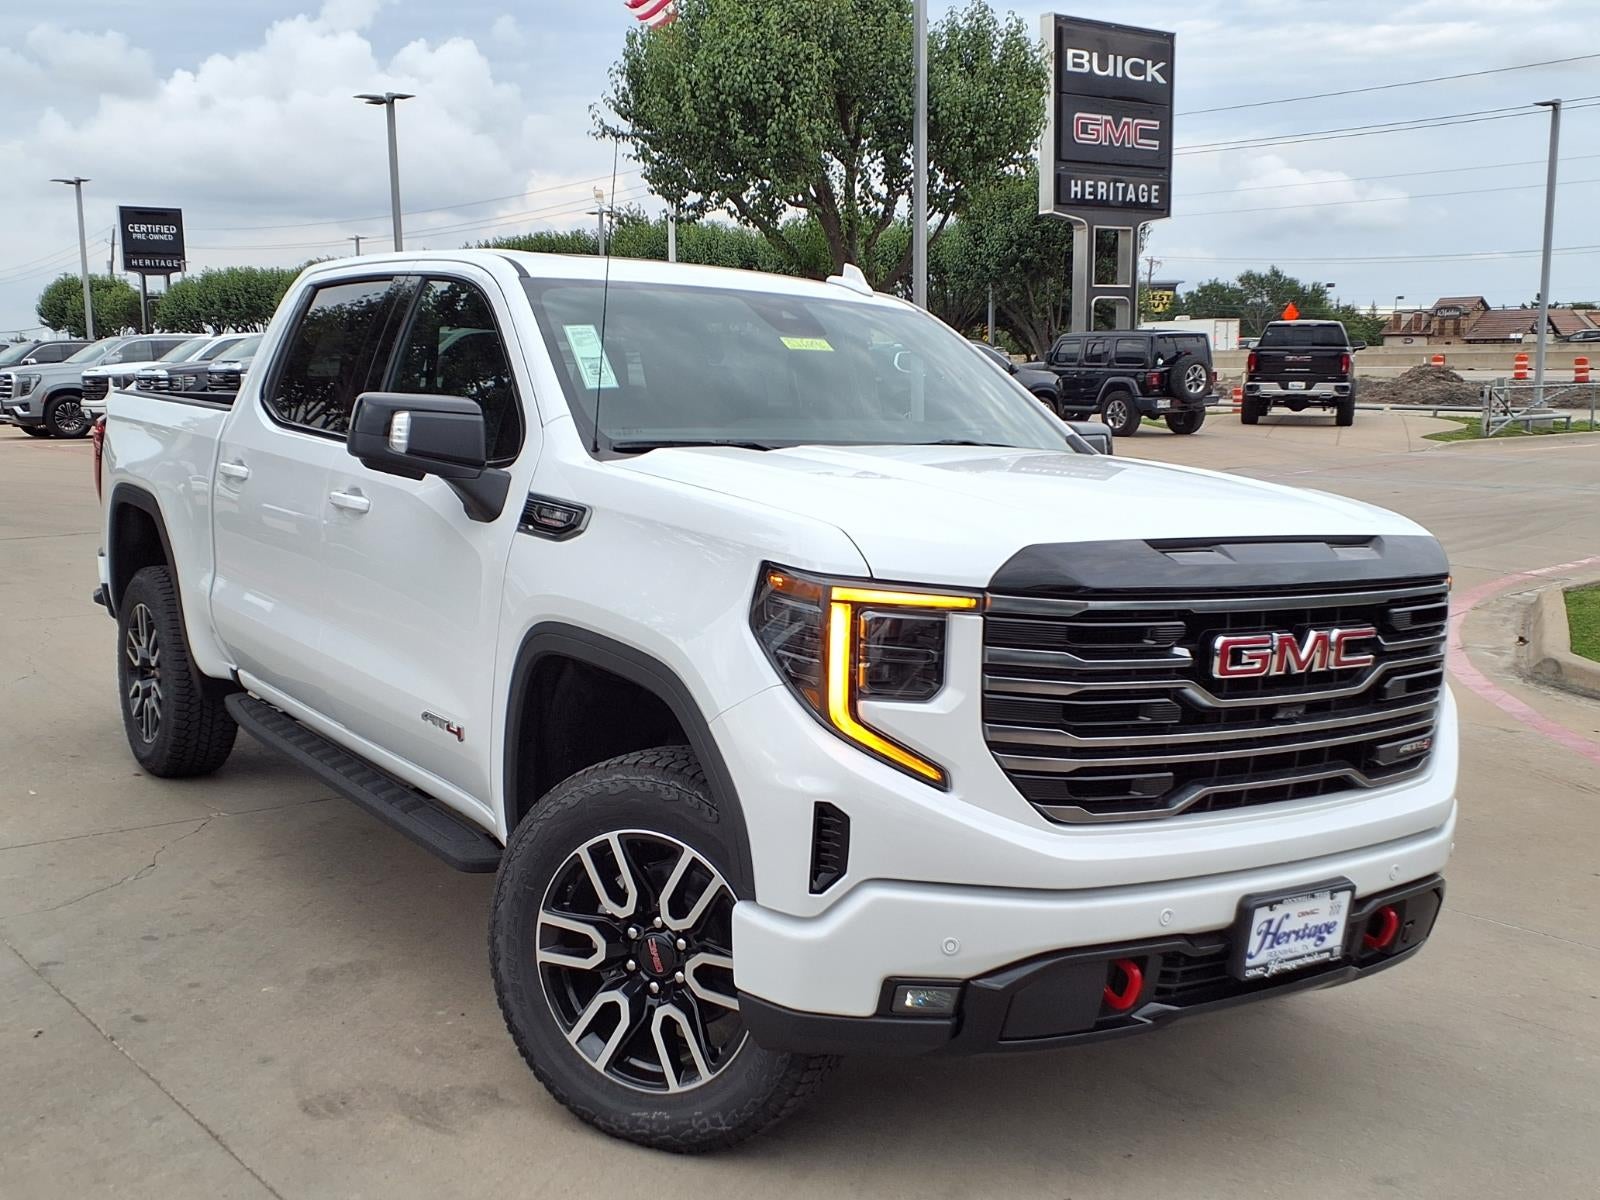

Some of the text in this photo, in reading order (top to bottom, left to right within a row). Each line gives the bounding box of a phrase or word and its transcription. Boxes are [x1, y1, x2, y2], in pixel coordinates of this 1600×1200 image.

[1066, 48, 1167, 84] BUICK
[1073, 112, 1160, 150] GMC
[1070, 179, 1160, 204] HERITAGE
[127, 223, 177, 234] CERTIFIED
[132, 233, 174, 241] PRE-OWNED
[131, 258, 180, 267] HERITAGE
[1212, 626, 1377, 679] GMC
[1246, 912, 1338, 960] Heritage
